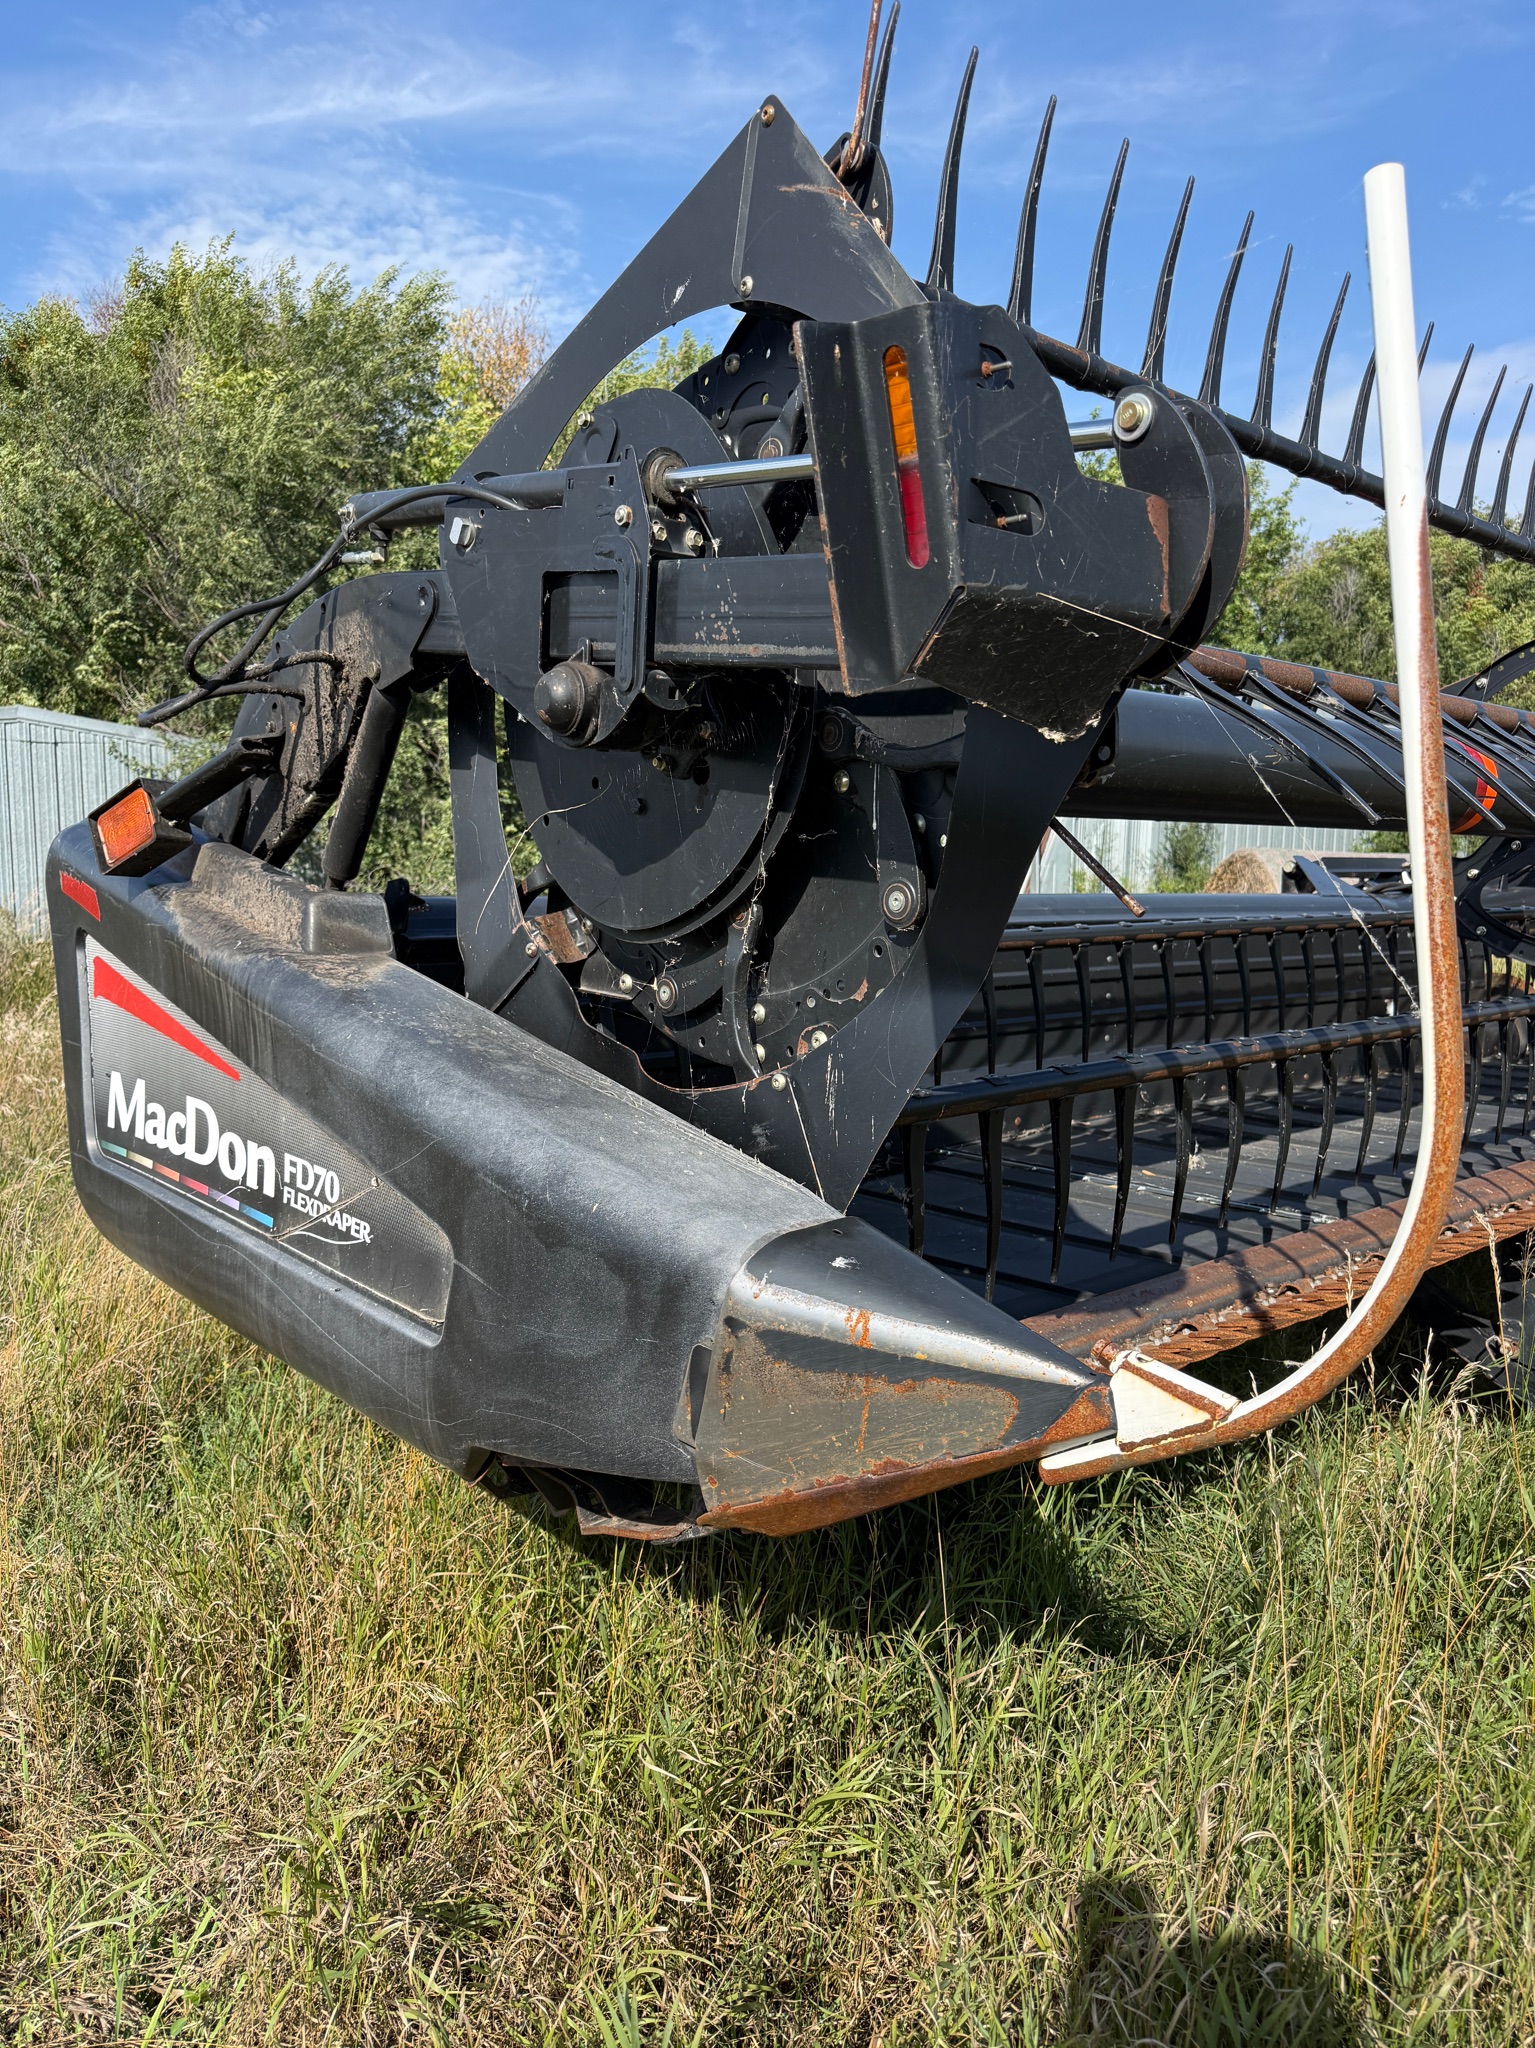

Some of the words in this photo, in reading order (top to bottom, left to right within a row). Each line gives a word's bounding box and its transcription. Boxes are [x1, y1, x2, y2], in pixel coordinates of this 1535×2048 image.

[107, 1070, 275, 1198] MacDon
[284, 1152, 340, 1203] FD70
[283, 1185, 372, 1243] FLEXDRAPER
